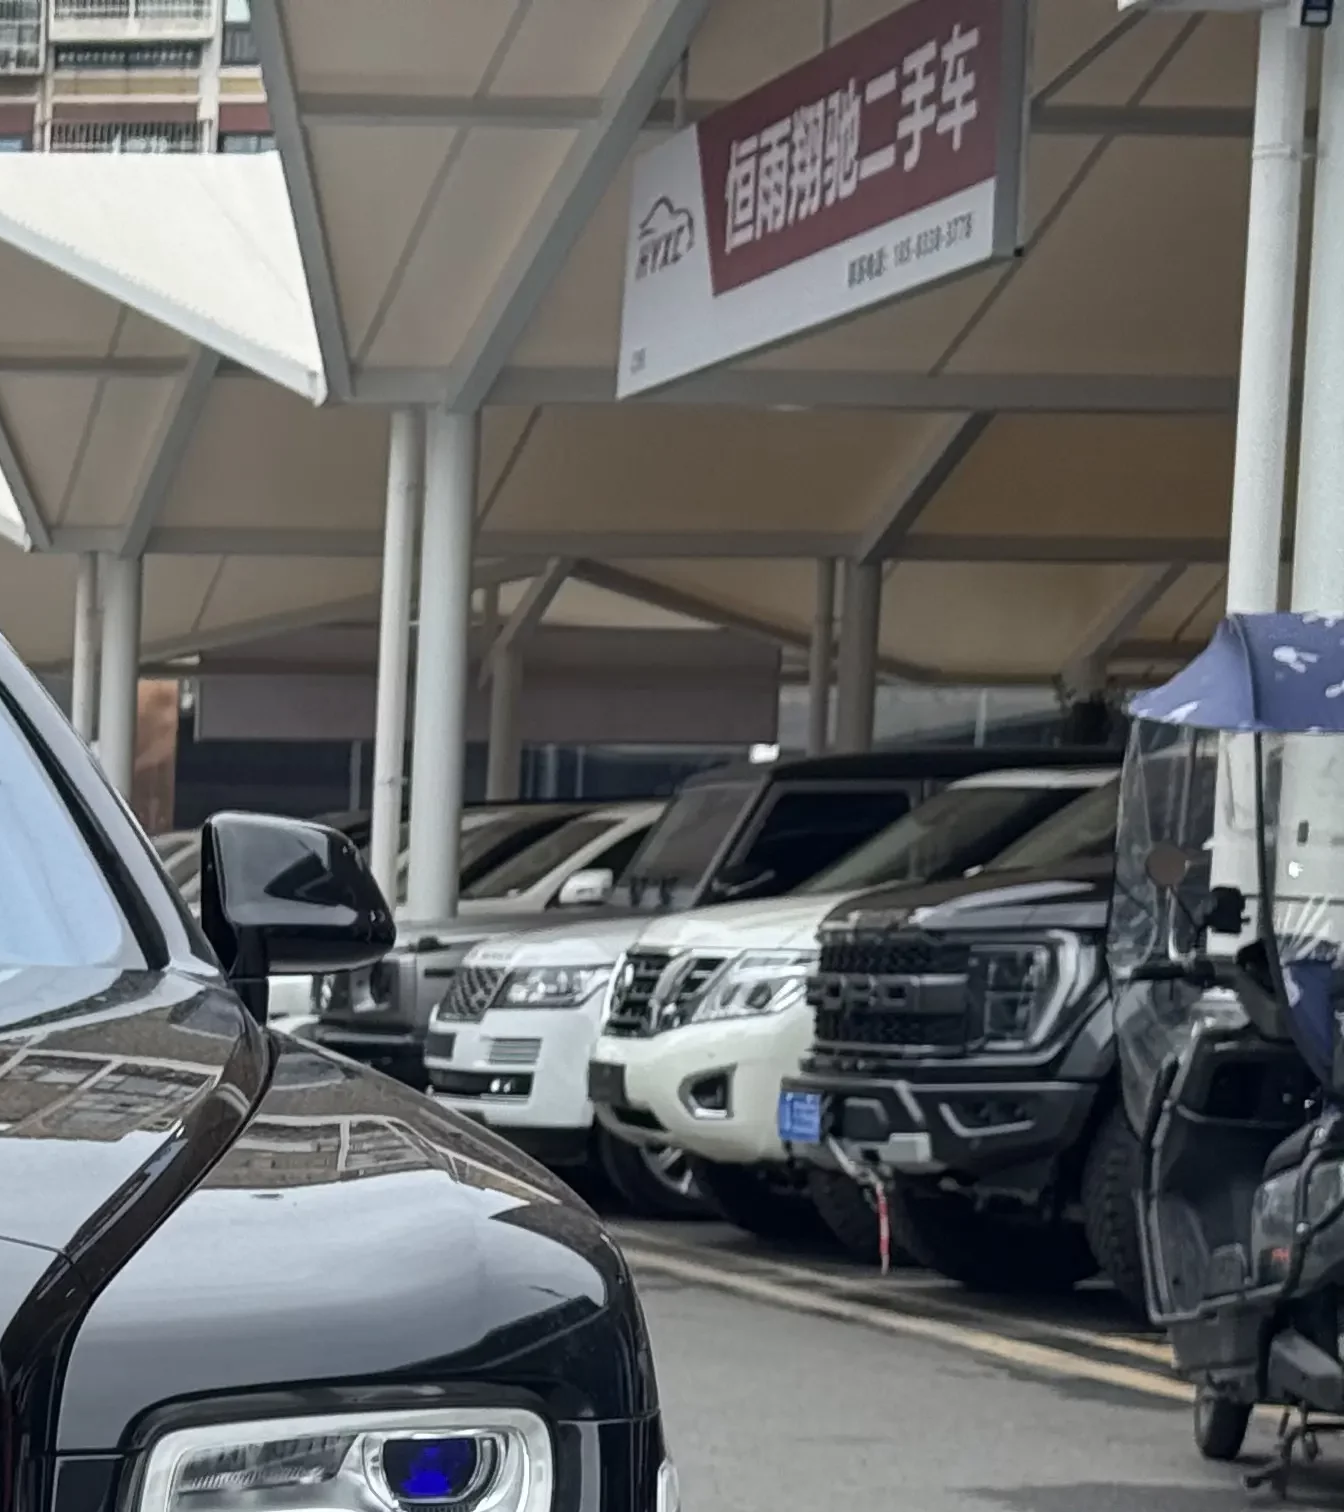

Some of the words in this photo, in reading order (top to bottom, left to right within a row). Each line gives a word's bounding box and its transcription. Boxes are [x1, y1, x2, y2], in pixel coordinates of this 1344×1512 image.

[724, 22, 980, 254] 恒雨翔驰二手车
